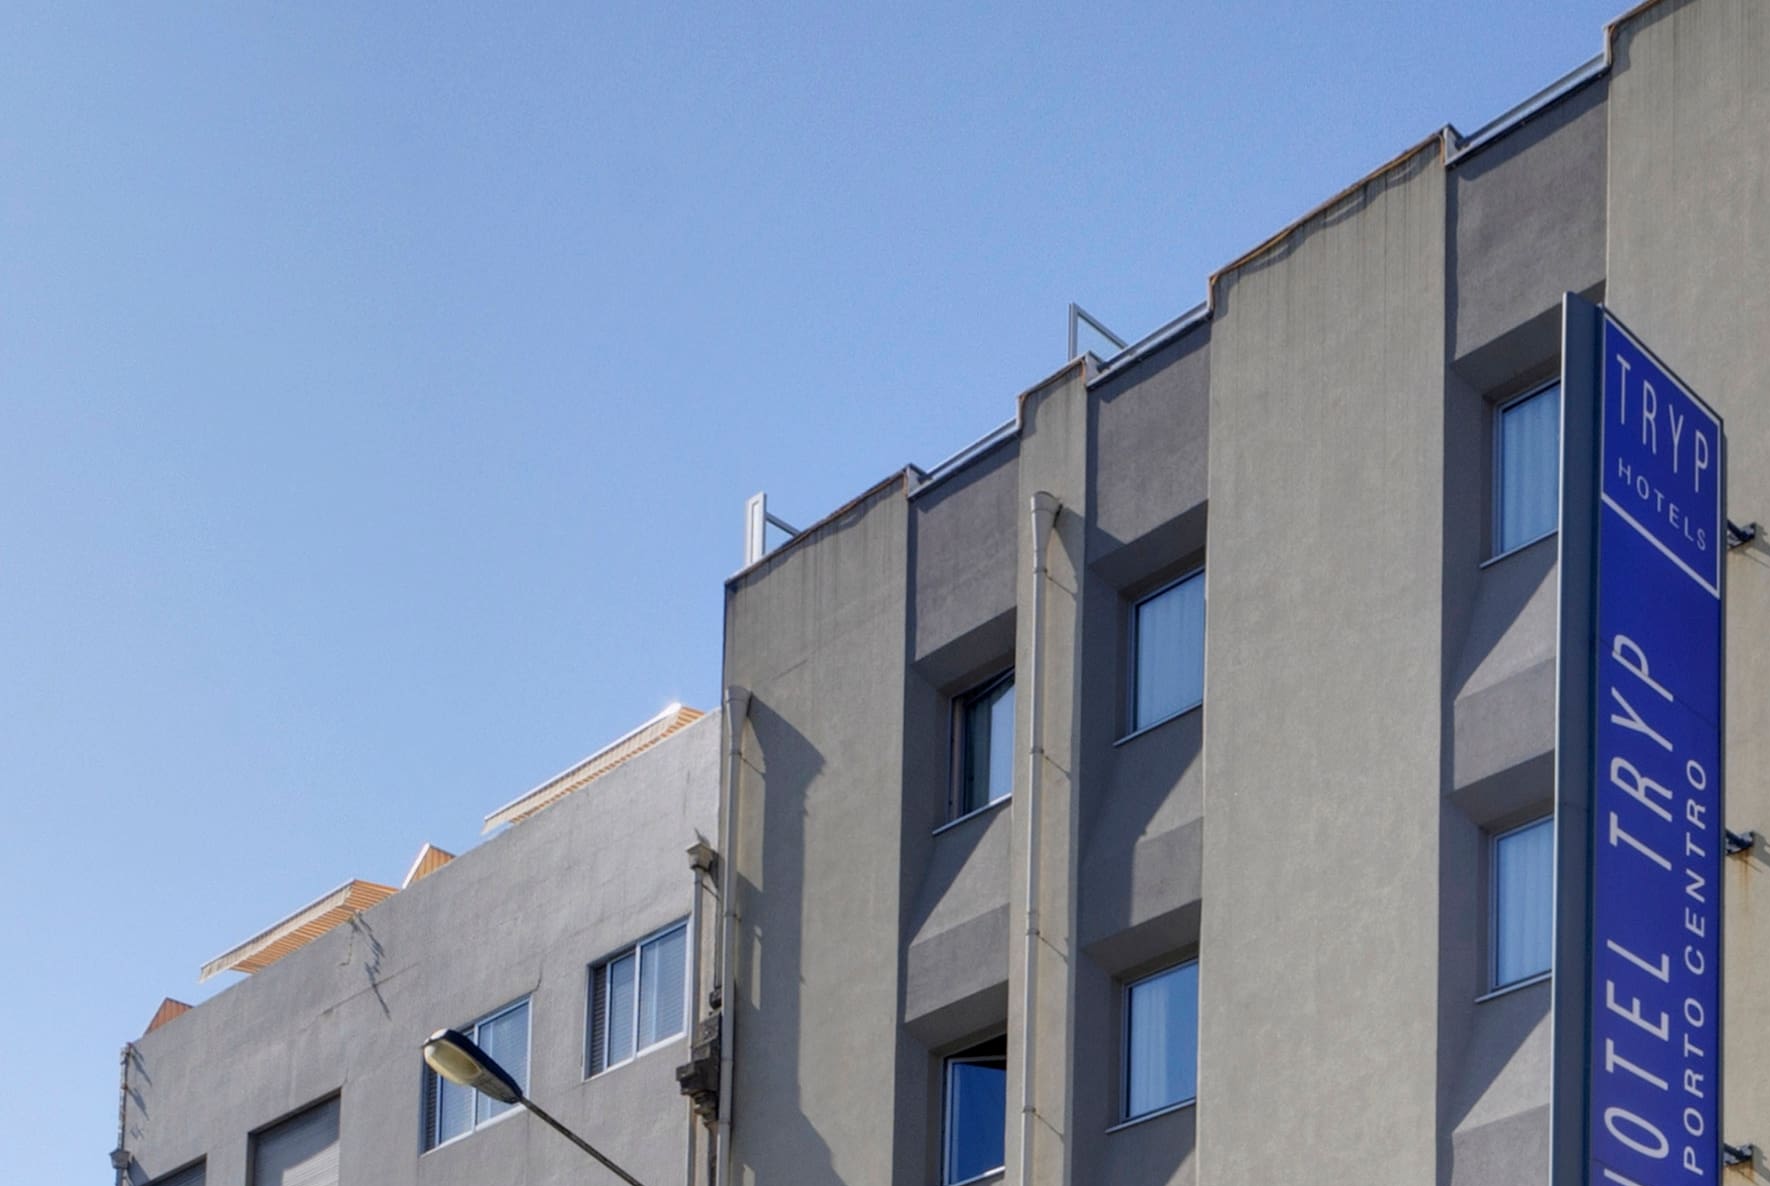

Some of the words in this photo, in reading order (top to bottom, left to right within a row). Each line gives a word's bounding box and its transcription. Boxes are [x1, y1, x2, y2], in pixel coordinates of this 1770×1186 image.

[1616, 354, 1709, 493] TRYP
[1617, 456, 1706, 552] HOTELS
[1608, 633, 1674, 872] TRYP
[1683, 759, 1708, 976] CENTRO
[1682, 996, 1705, 1177] PORTO
